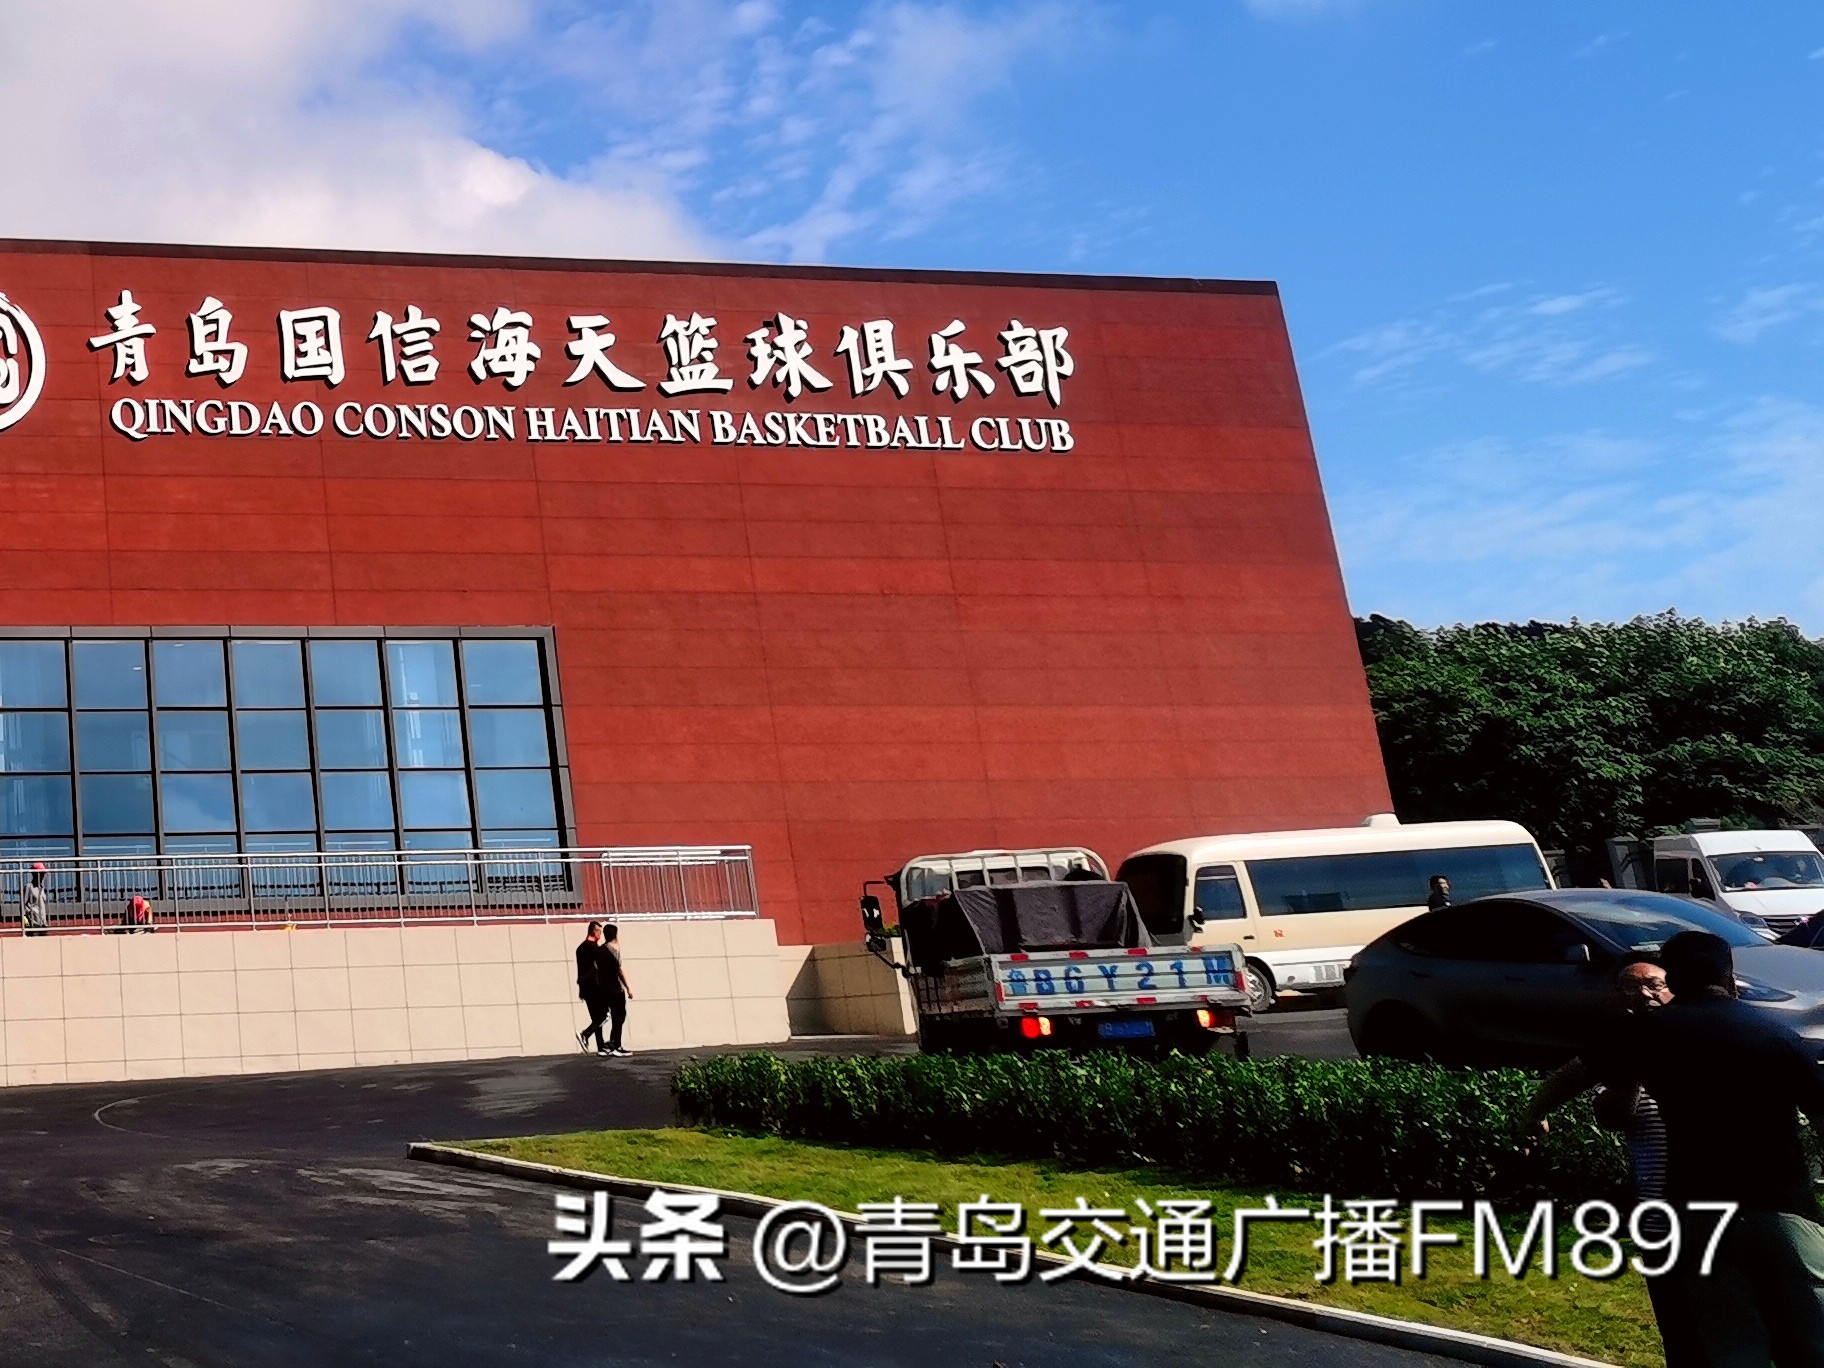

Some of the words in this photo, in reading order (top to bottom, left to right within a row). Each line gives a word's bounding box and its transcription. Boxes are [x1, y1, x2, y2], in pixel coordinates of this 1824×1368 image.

[89, 289, 1075, 407] 青岛国信海天篮球俱乐部
[111, 397, 324, 439] QINGDAO
[334, 401, 516, 440] CONSON
[525, 407, 701, 443] HAITIAN
[709, 410, 966, 449] BASKETBALL
[971, 416, 1075, 451] CLUB
